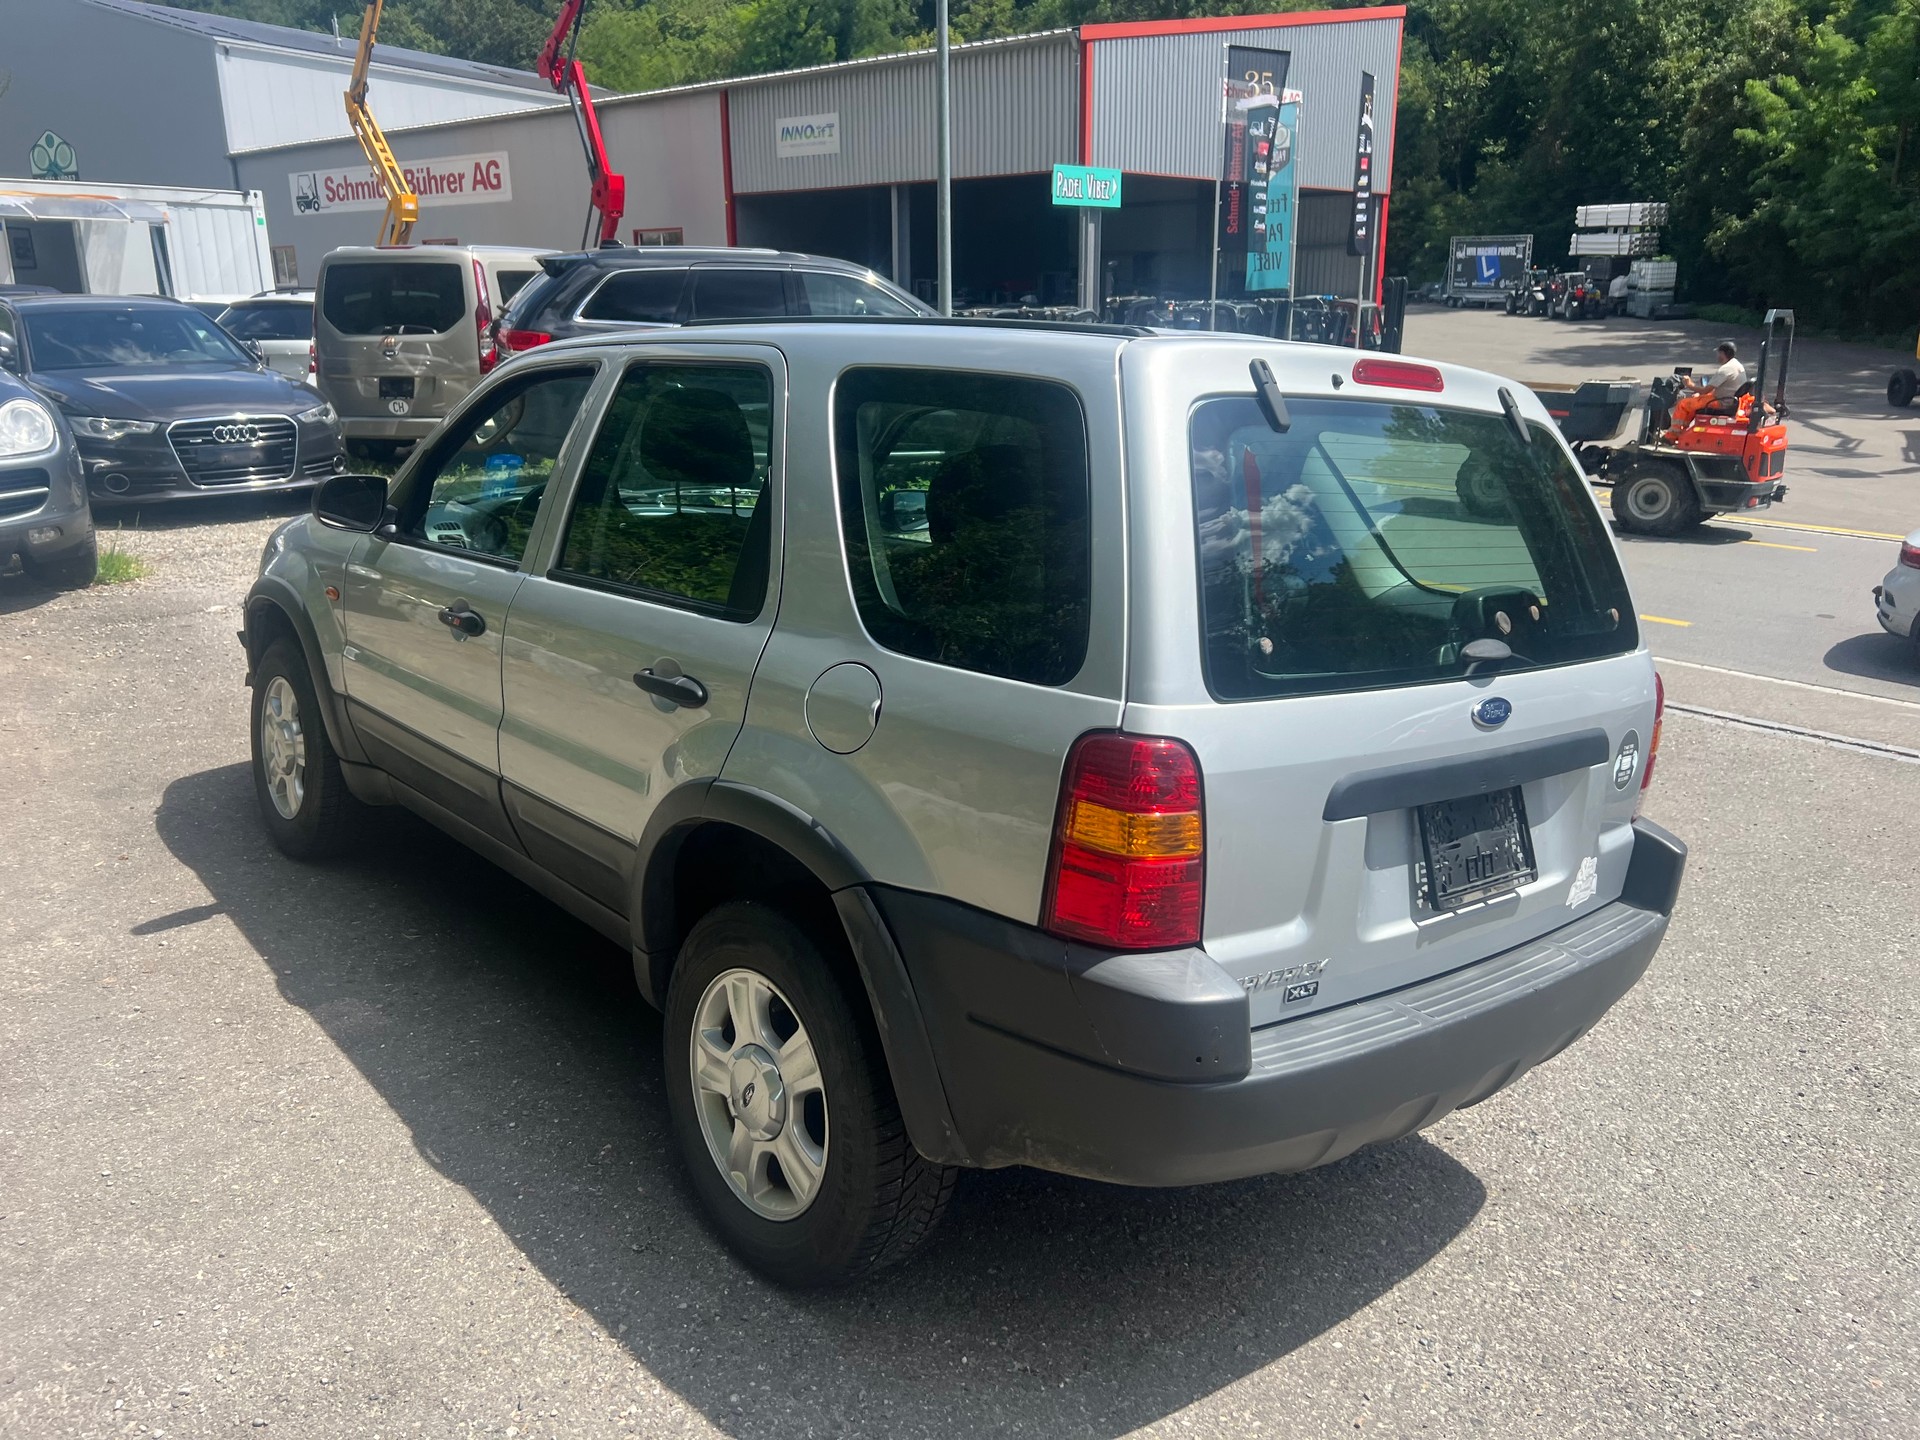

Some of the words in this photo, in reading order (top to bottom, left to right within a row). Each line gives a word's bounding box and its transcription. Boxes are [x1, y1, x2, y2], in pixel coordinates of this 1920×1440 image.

[1245, 70, 1273, 98] 35
[403, 166, 465, 196] Bührer
[472, 159, 502, 192] AG
[1227, 190, 1240, 233] Schmid
[1481, 256, 1495, 278] L
[393, 402, 405, 413] CH
[1289, 984, 1317, 1000] XLT
